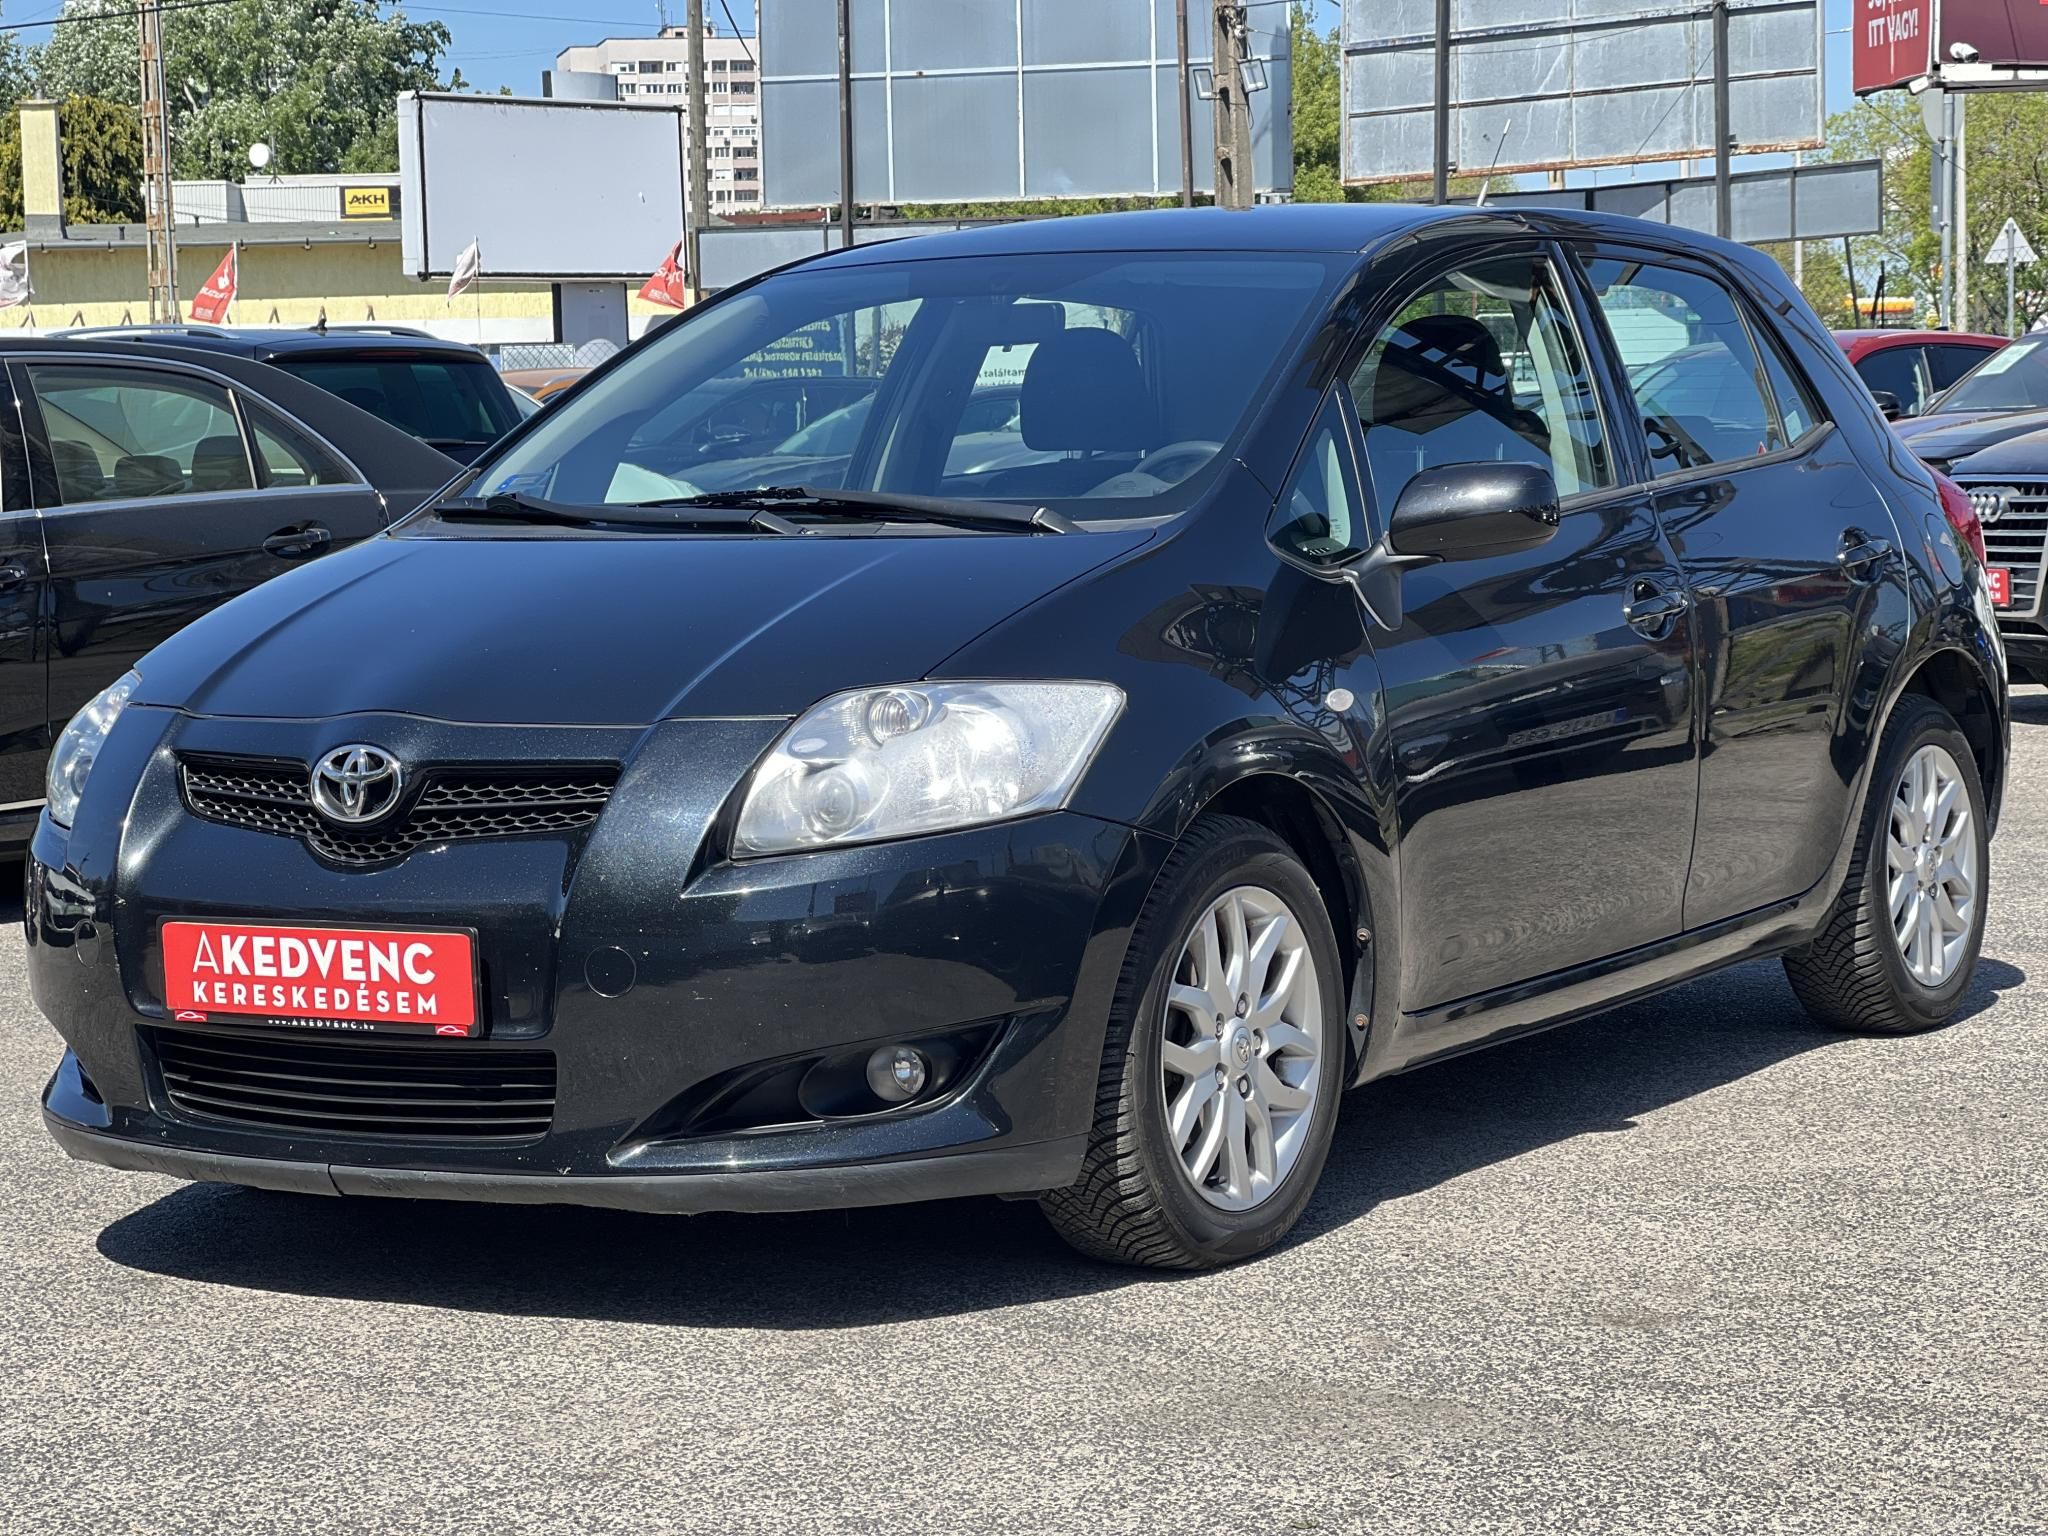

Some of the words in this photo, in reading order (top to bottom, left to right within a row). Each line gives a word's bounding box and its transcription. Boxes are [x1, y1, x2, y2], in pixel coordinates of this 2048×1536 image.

[1868, 17, 1886, 48] ITT
[1886, 7, 1919, 43] VAGY!
[348, 193, 385, 205] AKH
[193, 981, 438, 1016] KERESKEDÉSEM
